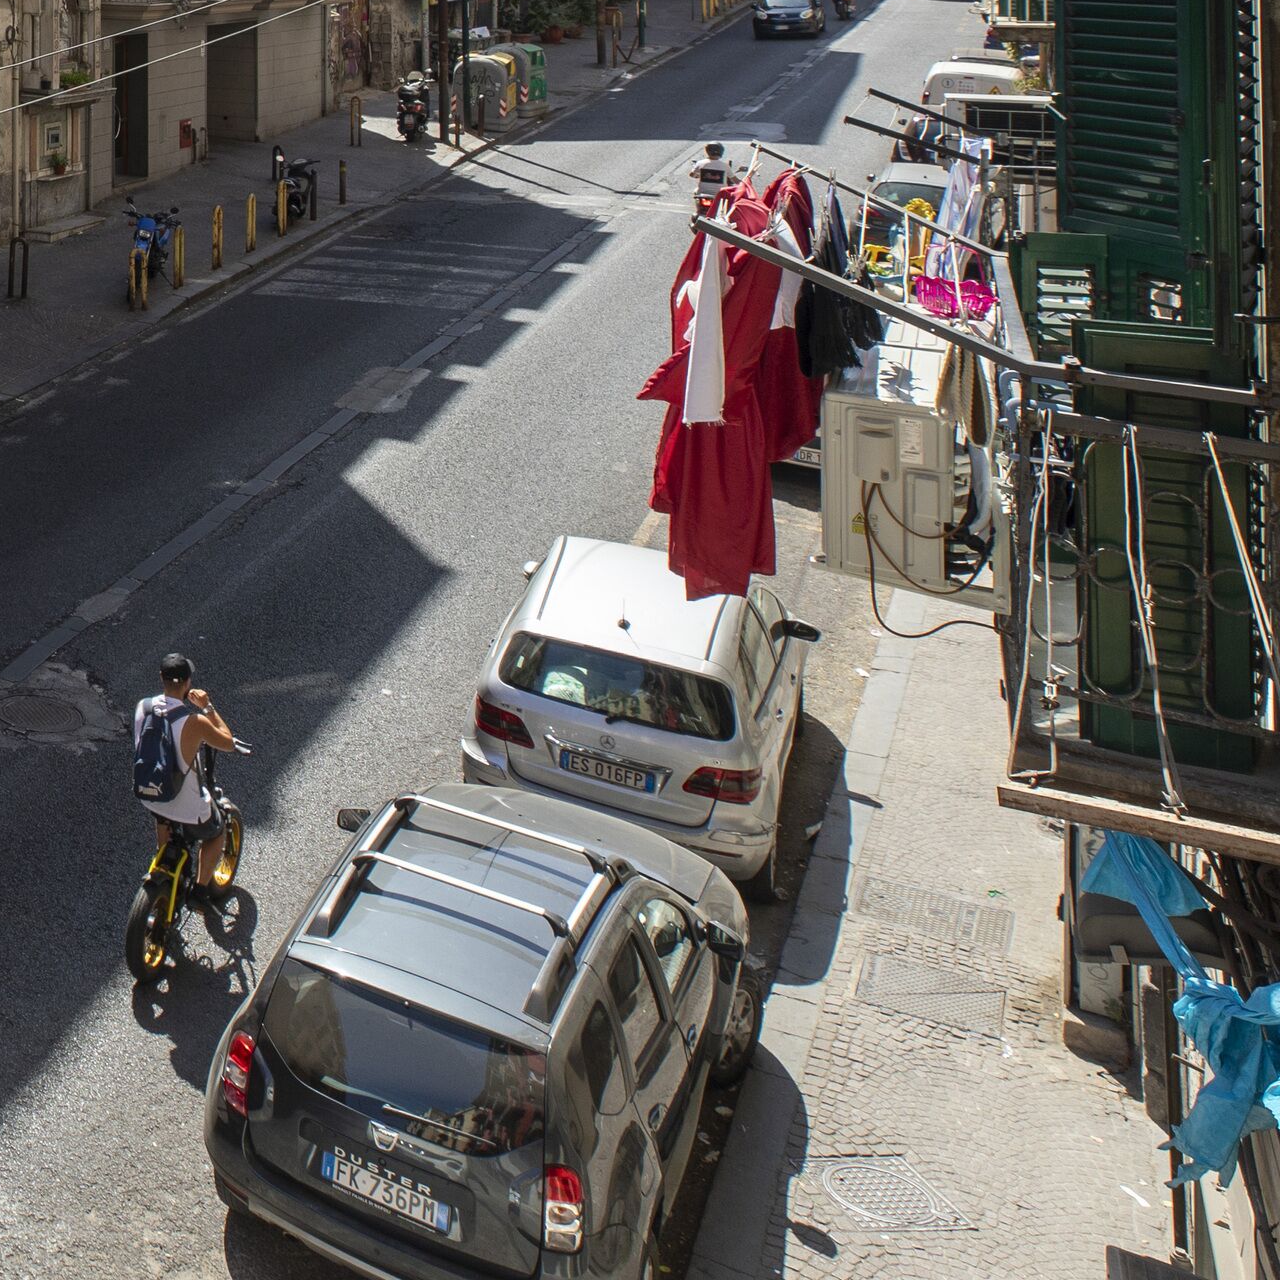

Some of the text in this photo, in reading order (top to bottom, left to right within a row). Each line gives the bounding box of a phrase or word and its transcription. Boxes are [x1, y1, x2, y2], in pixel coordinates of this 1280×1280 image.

[570, 754, 644, 788] ES 016FP
[334, 1145, 432, 1197] DUSTER
[335, 1159, 360, 1190] FK
[369, 1175, 435, 1225] 736PM
